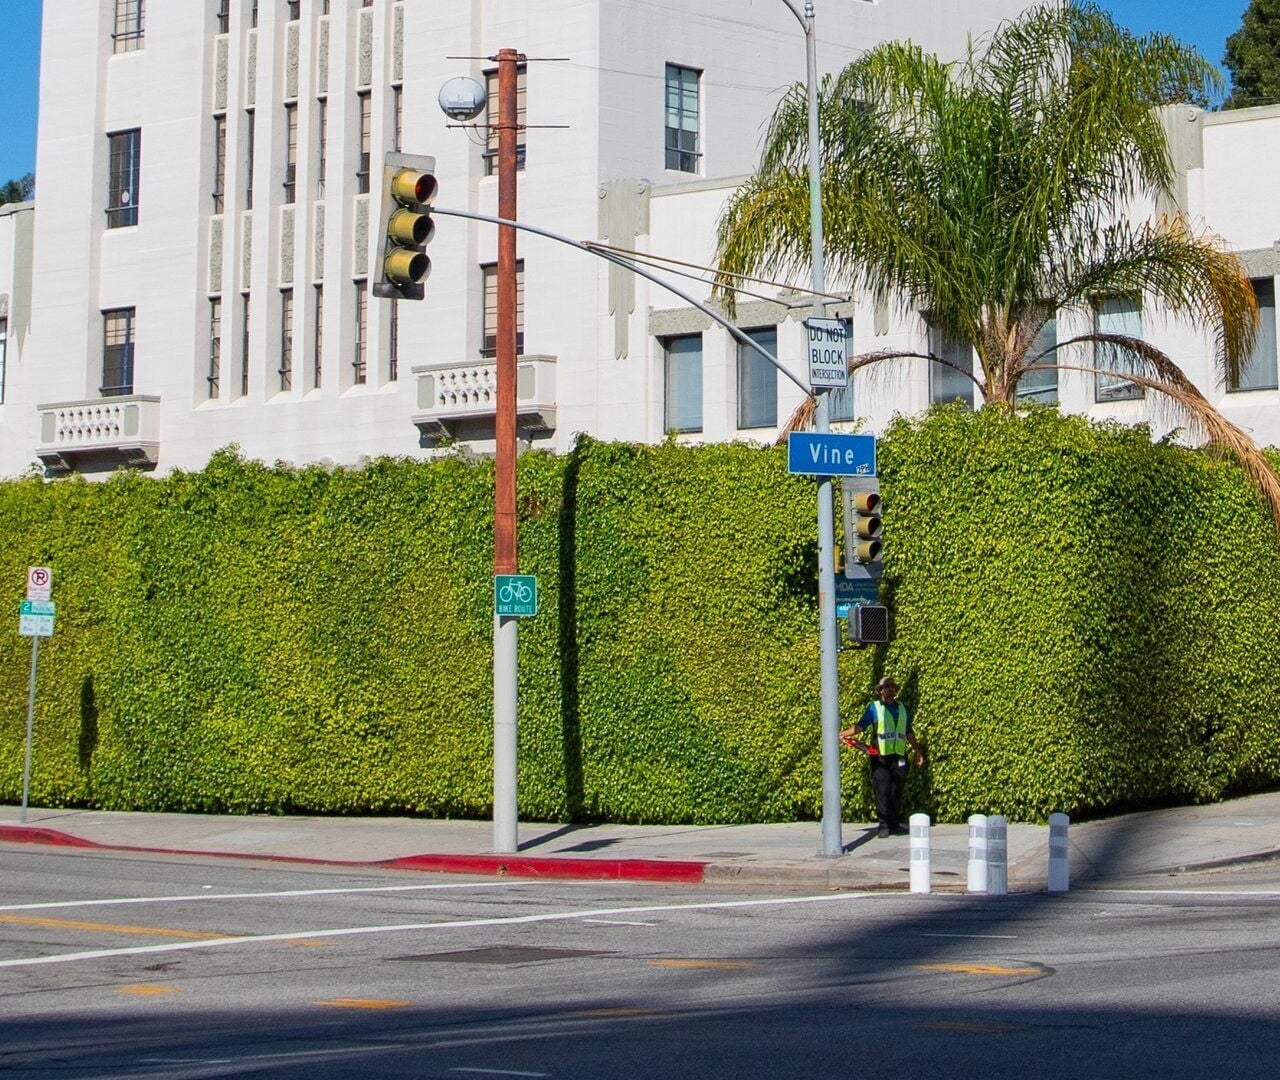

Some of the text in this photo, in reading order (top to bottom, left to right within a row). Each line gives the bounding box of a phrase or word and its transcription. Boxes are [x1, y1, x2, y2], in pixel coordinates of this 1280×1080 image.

[810, 326, 844, 343] DO NOT
[812, 348, 844, 365] BLOCK
[812, 368, 845, 380] INTERSECTION
[810, 443, 854, 464] Vine
[24, 603, 30, 611] 2
[499, 604, 533, 613] BIKE ROUTE
